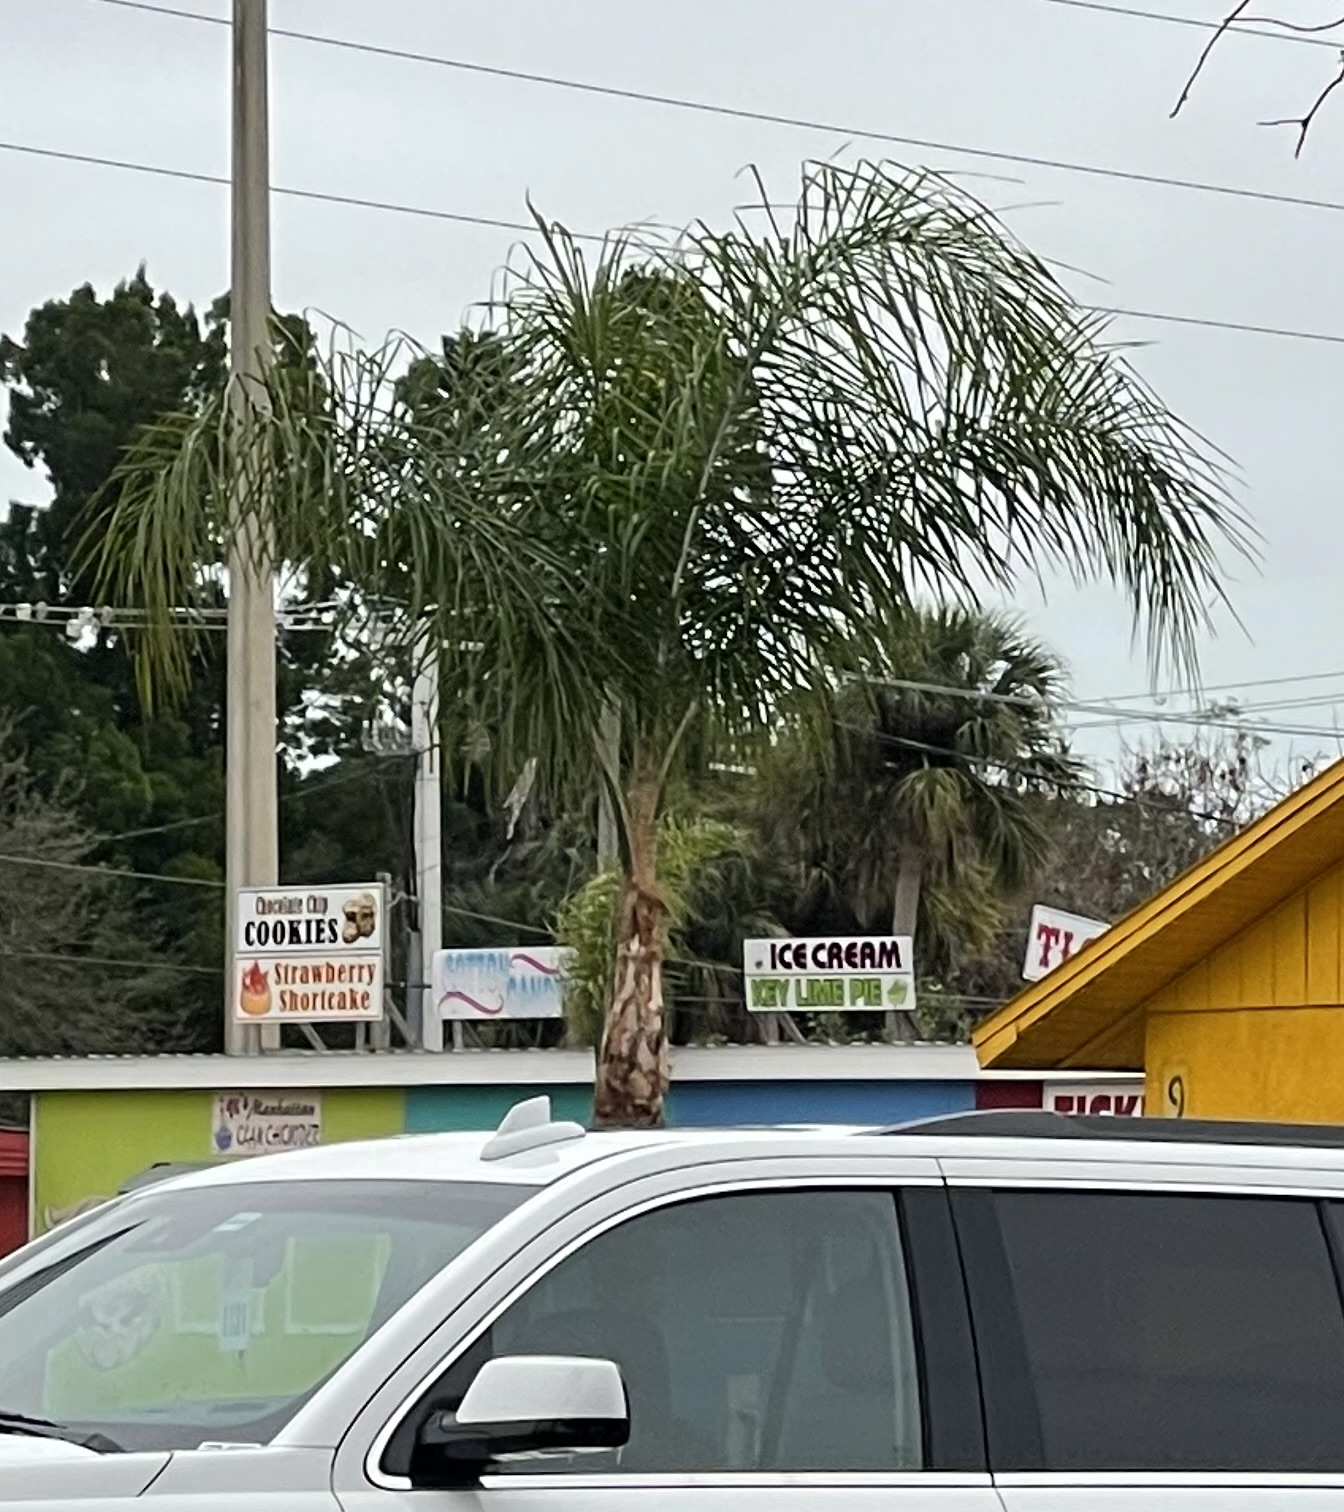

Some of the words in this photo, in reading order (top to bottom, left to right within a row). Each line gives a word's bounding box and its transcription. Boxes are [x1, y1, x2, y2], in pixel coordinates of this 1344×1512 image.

[244, 918, 338, 947] COOKIES
[1036, 923, 1094, 968] TI
[770, 942, 807, 970] ICE
[811, 940, 902, 969] CREAM
[274, 961, 376, 986] Strawberry
[279, 987, 371, 1012] Shortcake
[751, 978, 790, 1007] KEY
[795, 978, 845, 1007] LIME
[849, 978, 883, 1007] PIE
